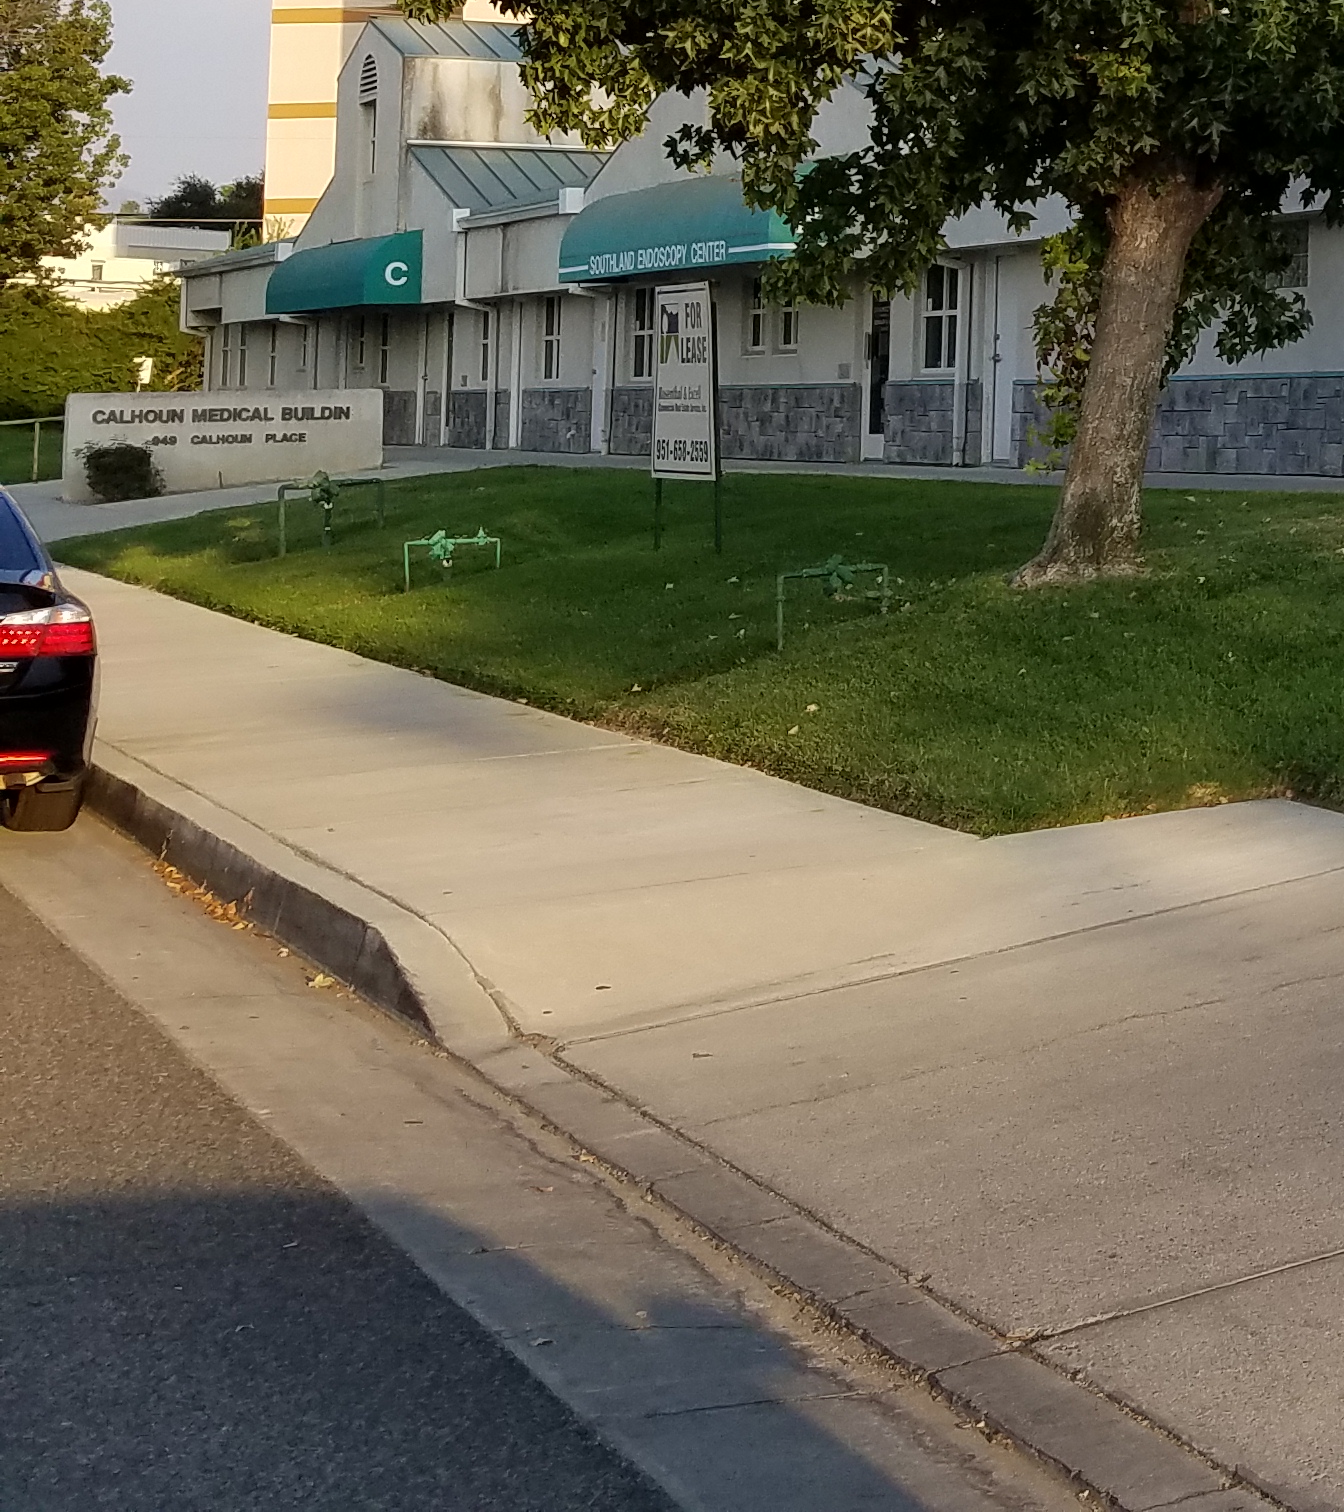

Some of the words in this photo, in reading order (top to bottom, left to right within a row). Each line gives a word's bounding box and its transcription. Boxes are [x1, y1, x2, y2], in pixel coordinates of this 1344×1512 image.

[589, 251, 635, 275] SOUTHLAND
[637, 244, 688, 269] ENDOSCOPY
[690, 240, 726, 264] CENTER
[384, 261, 408, 286] C
[684, 302, 702, 330] FOR
[681, 336, 707, 364] LEASE
[92, 408, 184, 425] CALHOUN
[191, 407, 275, 423] MEDICAL
[281, 406, 350, 421] BUILDIN
[190, 434, 252, 445] CALHOUN
[265, 433, 307, 443] PLACE
[656, 440, 709, 463] 951-658-2559
